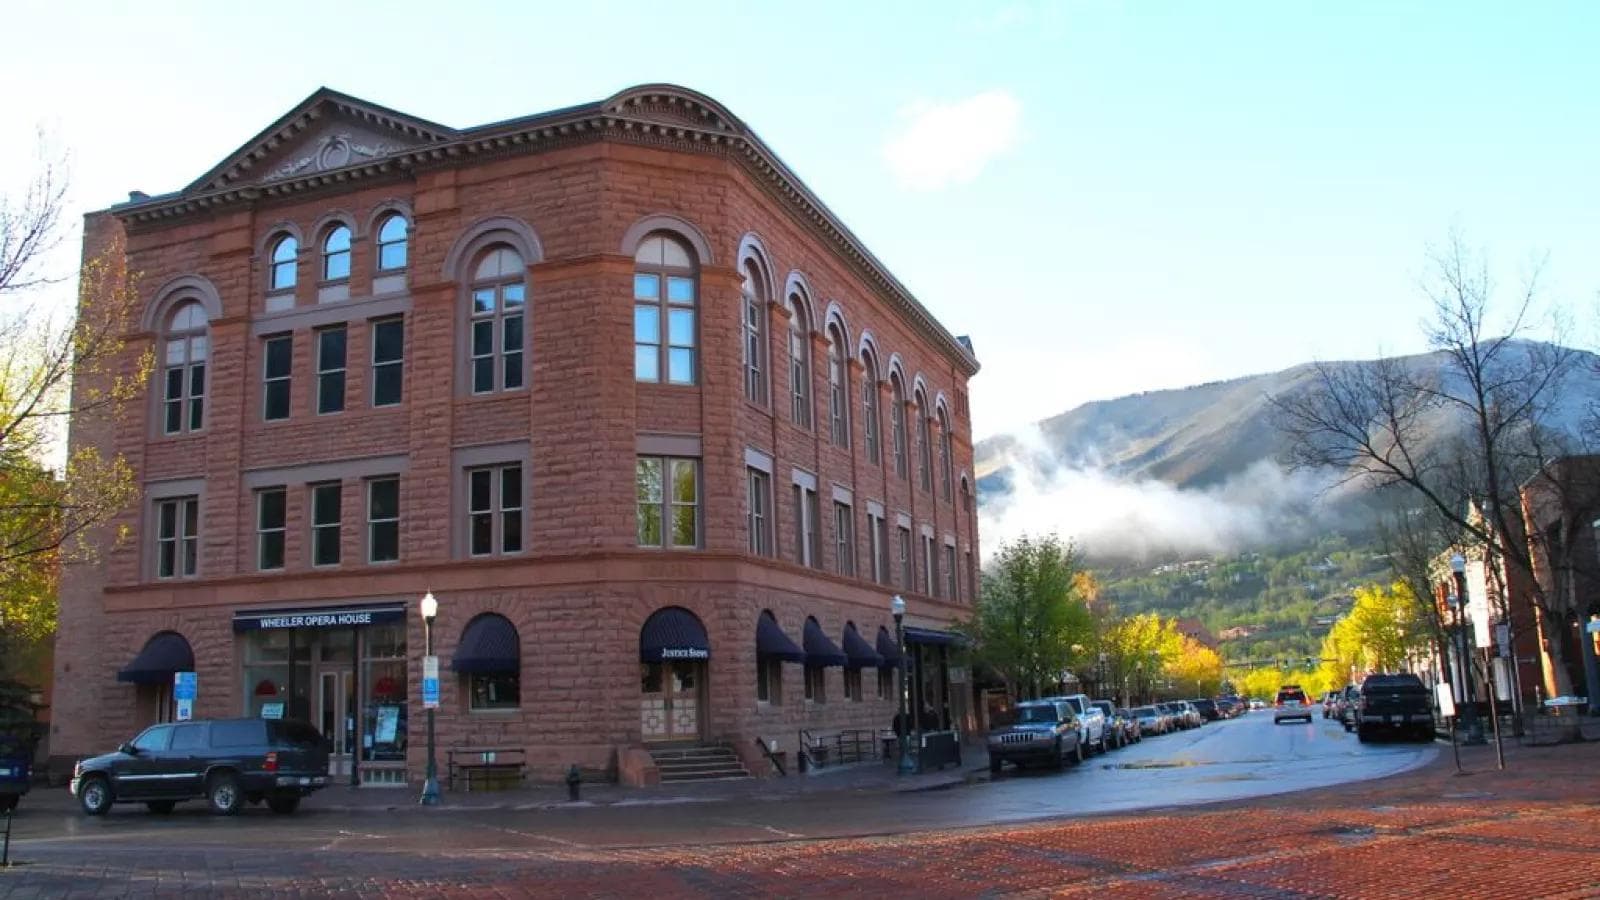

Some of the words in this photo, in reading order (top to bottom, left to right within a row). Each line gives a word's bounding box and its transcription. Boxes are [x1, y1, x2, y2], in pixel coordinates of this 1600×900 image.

[261, 617, 304, 628] WHEELER
[305, 615, 337, 626] OPERA
[338, 613, 371, 624] HOUSE
